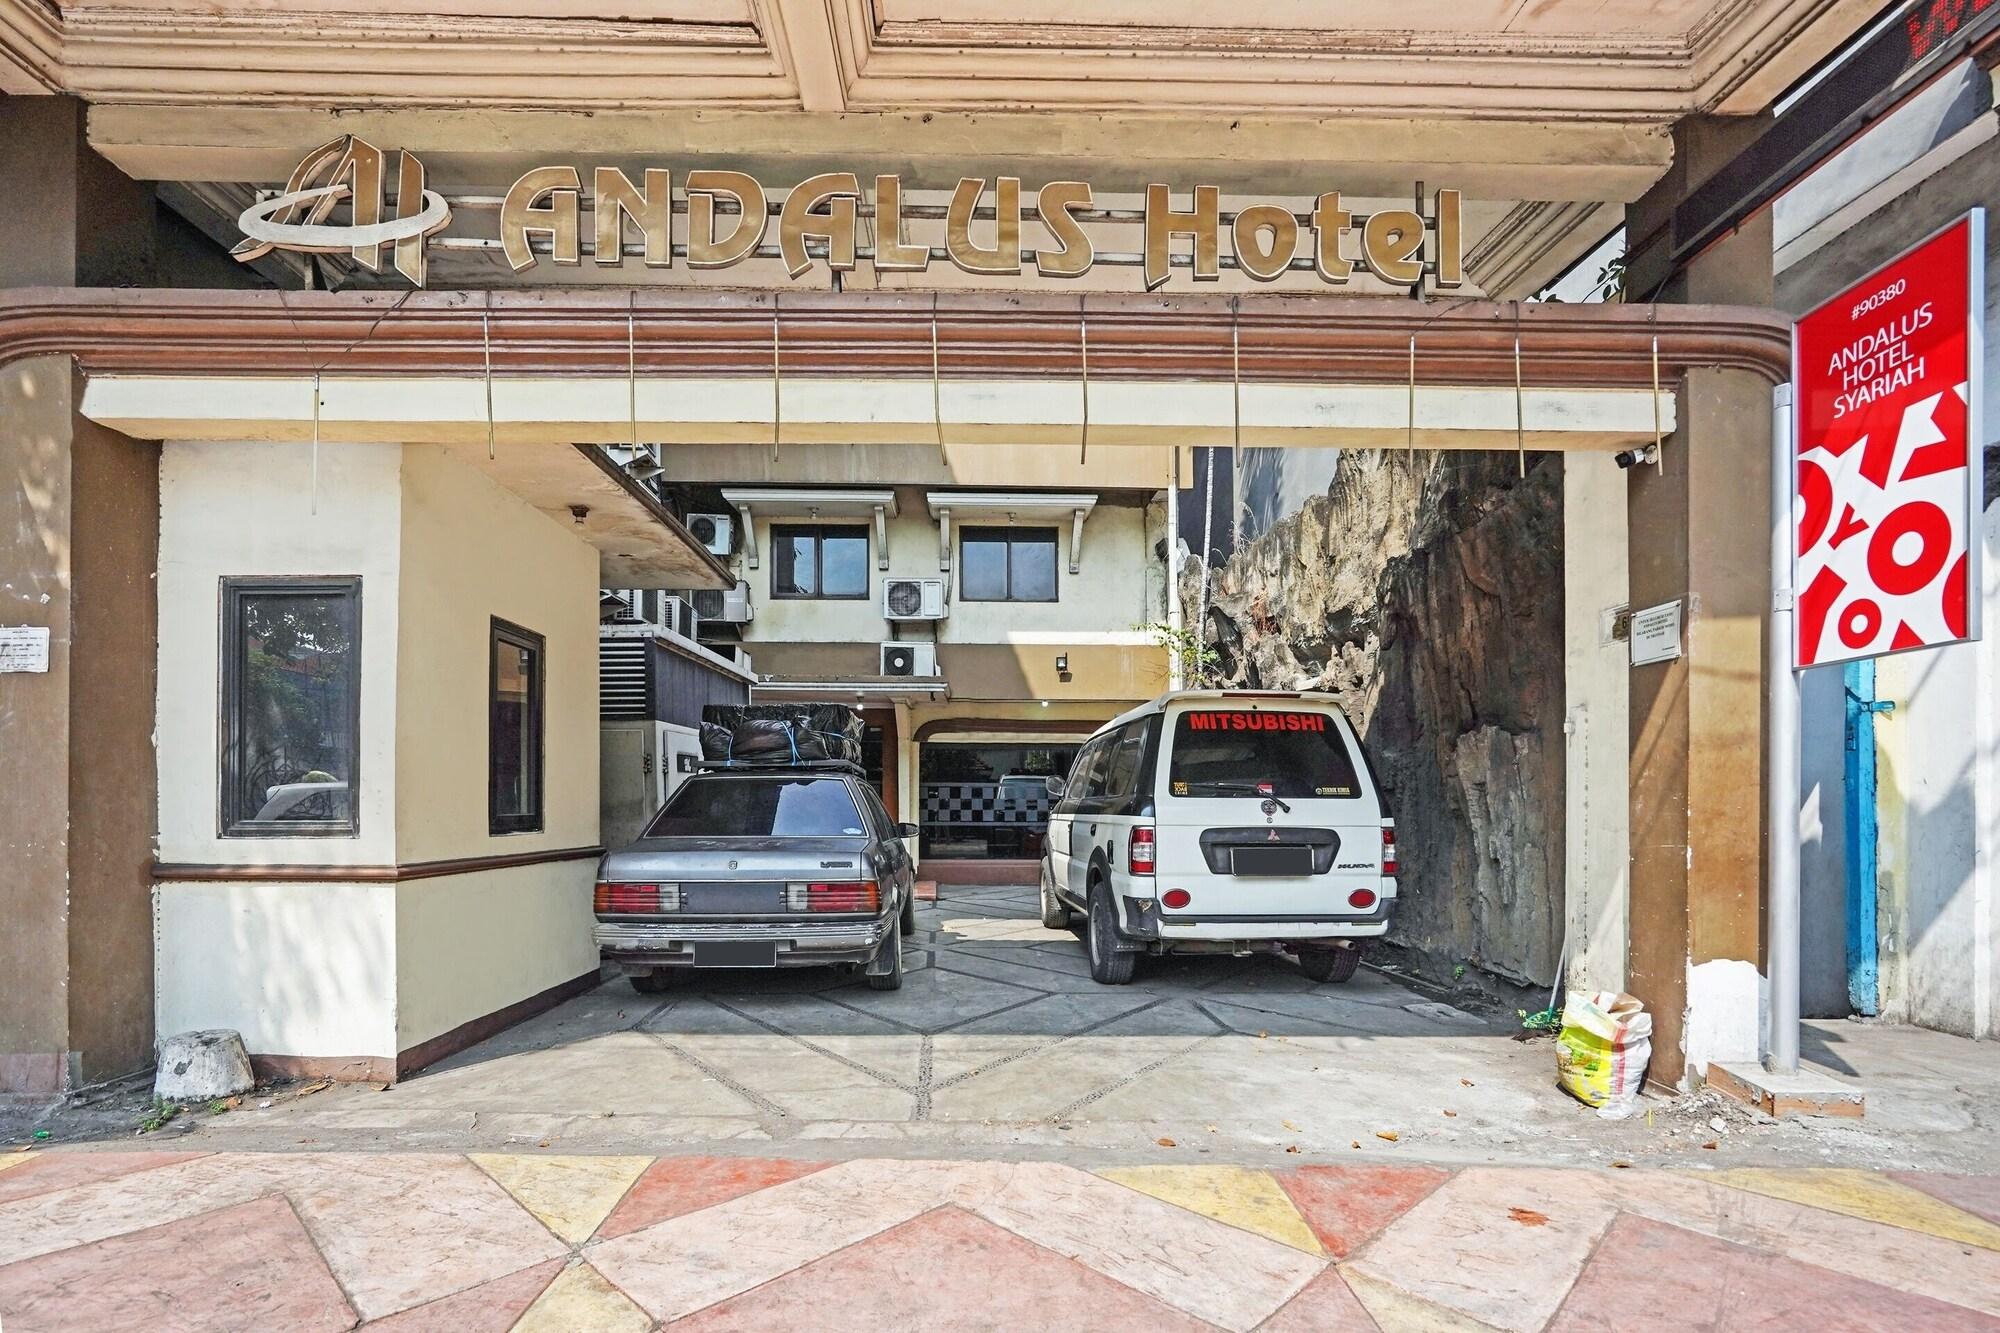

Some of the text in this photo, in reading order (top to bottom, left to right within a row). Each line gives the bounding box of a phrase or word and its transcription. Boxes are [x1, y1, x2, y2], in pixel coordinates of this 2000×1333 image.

[501, 166, 1462, 292] ANDALUS Hotel
[1851, 278, 1906, 321] #90380
[1828, 301, 1934, 376] ANDALUS
[1843, 340, 1915, 391] HOTEL
[1833, 356, 1925, 419] SYARIAH
[1190, 713, 1325, 732] MITSUBISHI
